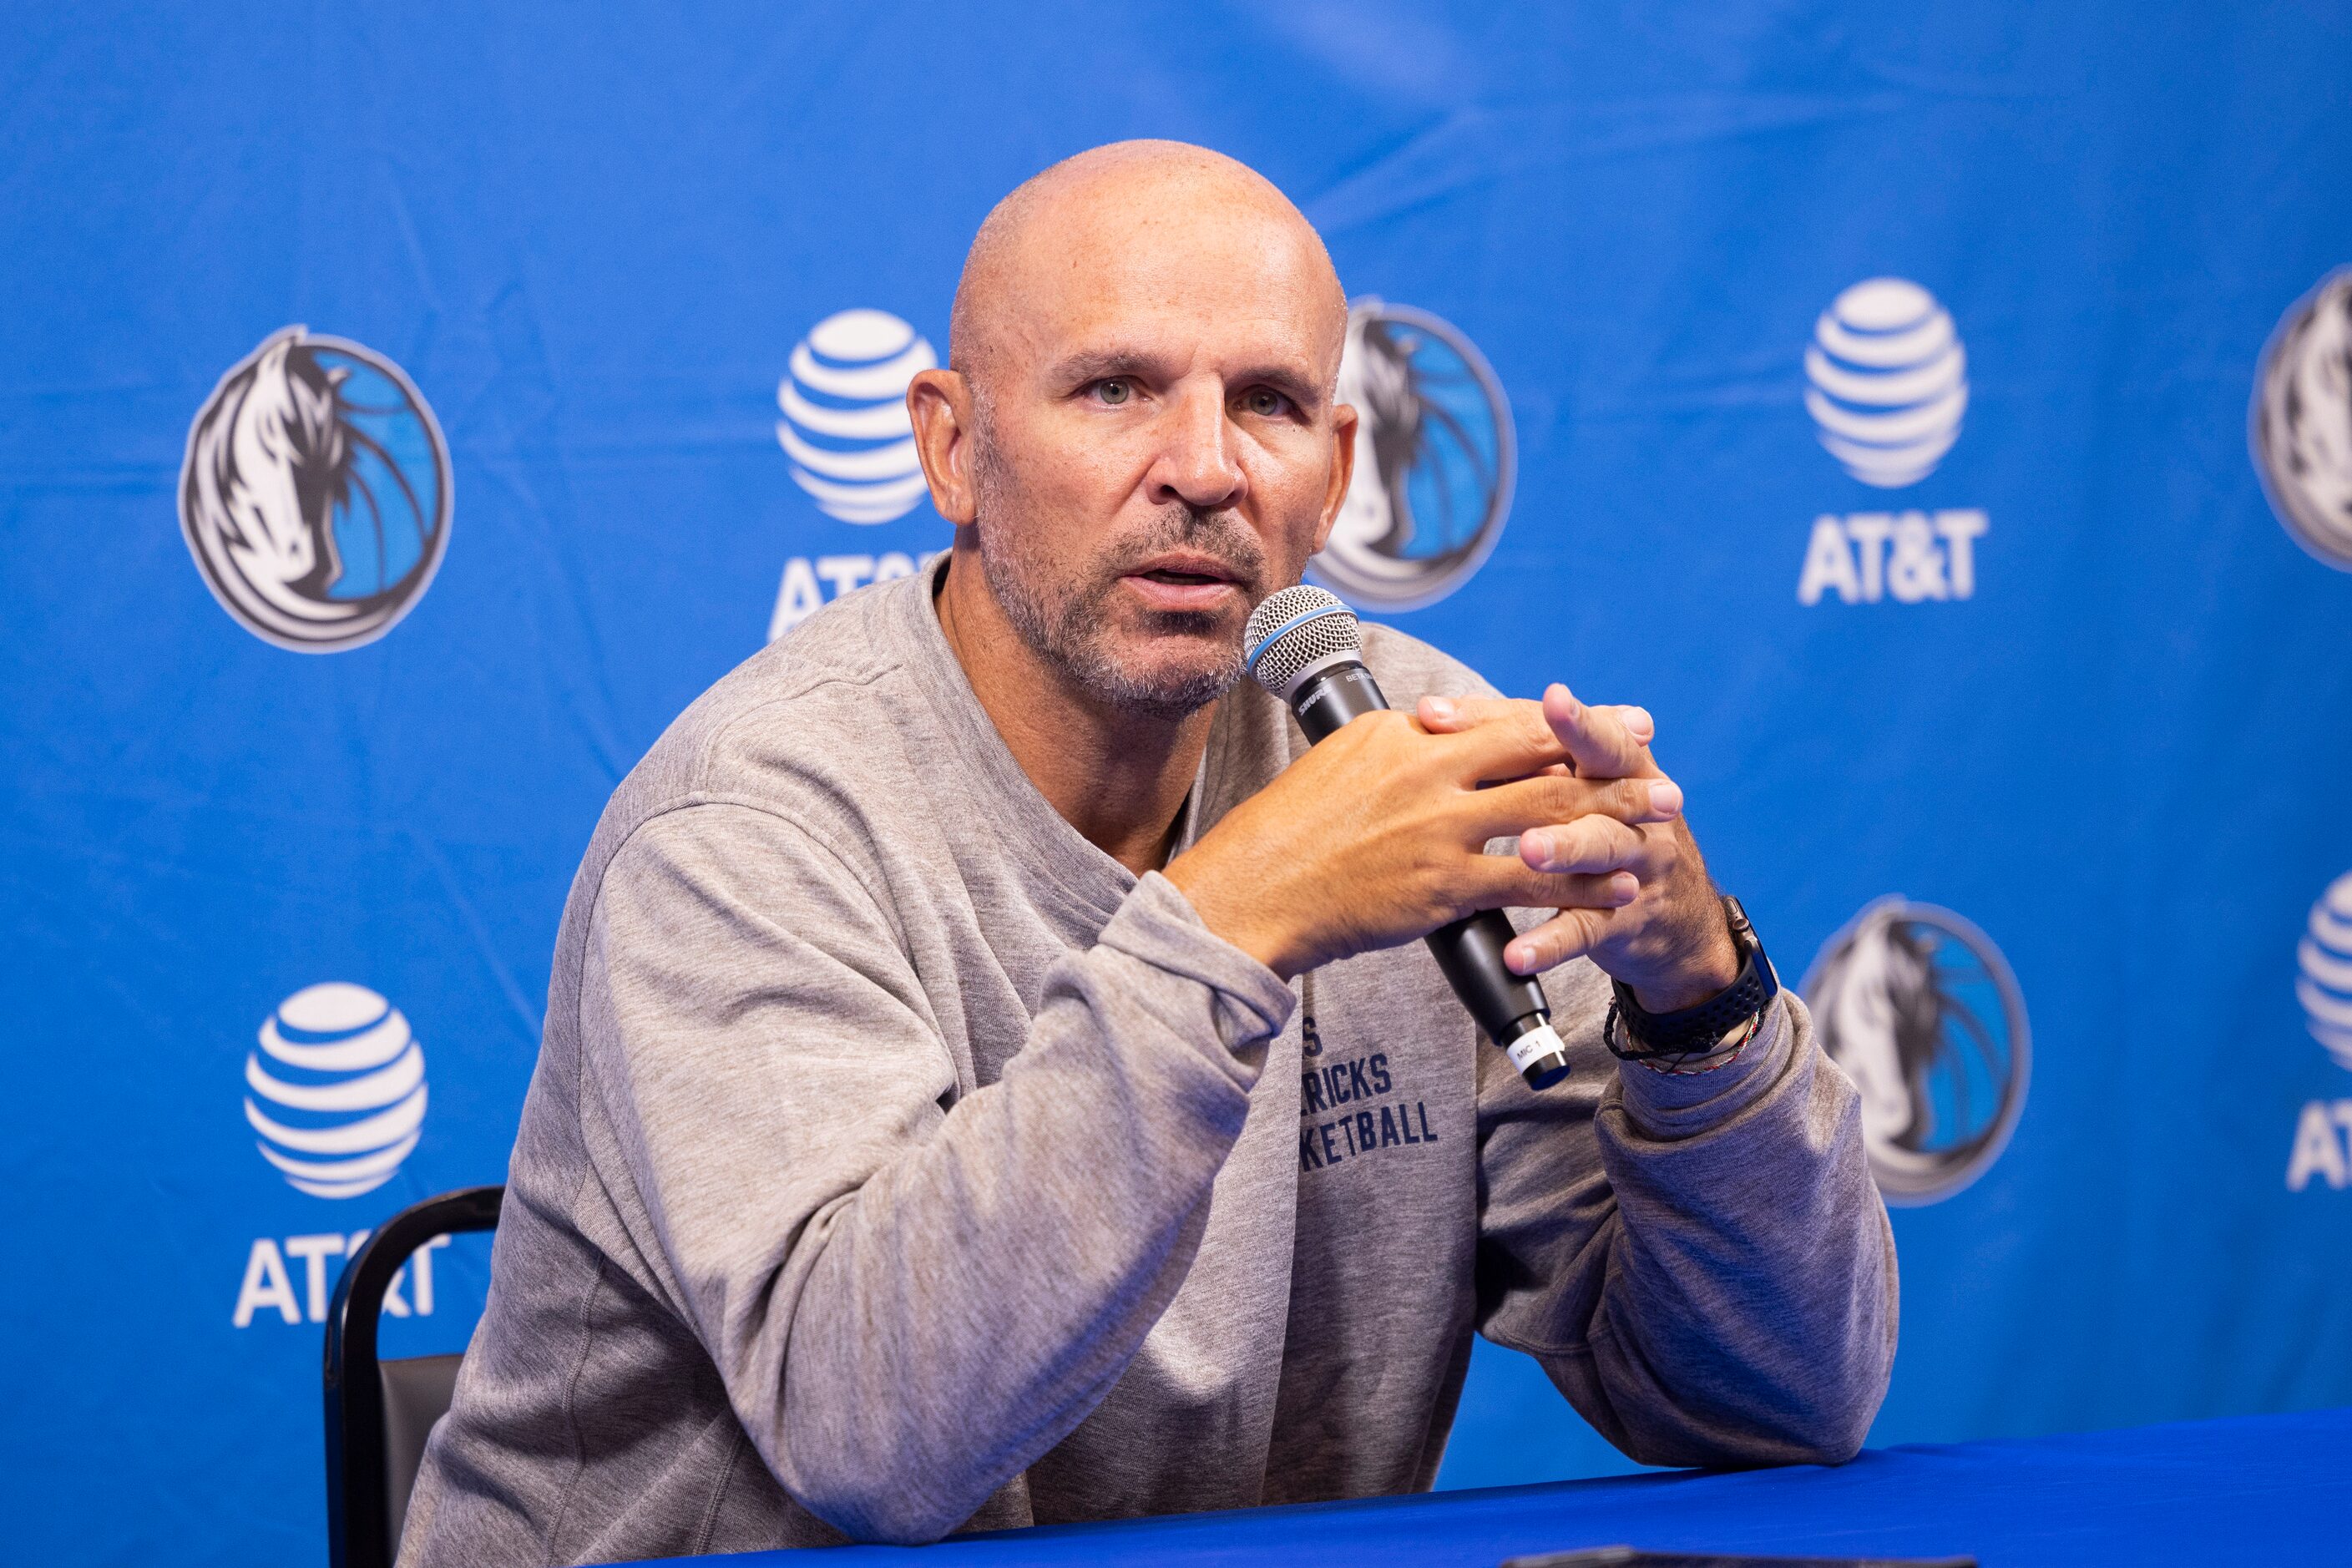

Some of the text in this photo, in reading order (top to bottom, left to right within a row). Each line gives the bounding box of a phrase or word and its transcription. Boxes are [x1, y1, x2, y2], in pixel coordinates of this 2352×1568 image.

[1798, 509, 1988, 606] AT&T
[1298, 684, 1333, 716] SHURE
[1516, 1044, 1534, 1060] MIC
[1300, 1053, 1393, 1117] RICKS
